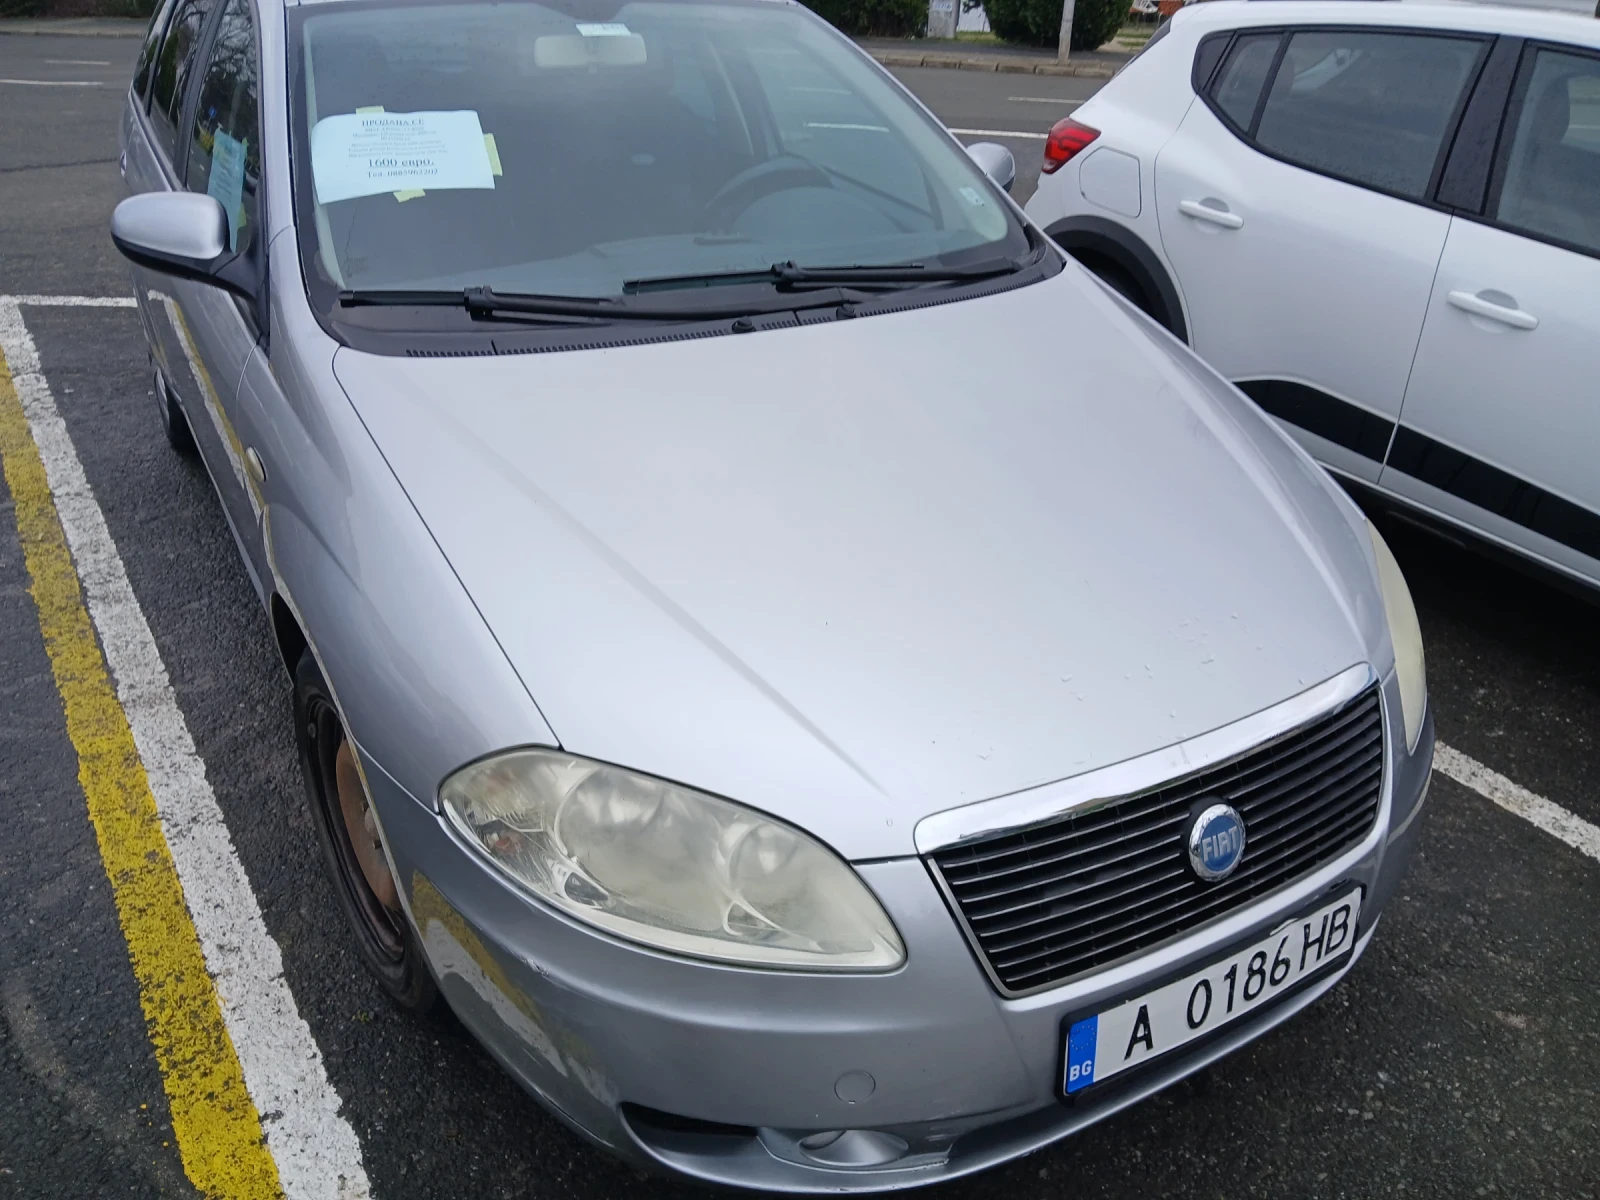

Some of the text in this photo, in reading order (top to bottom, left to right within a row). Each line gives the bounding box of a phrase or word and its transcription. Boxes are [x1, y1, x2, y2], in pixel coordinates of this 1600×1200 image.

[362, 119, 409, 127] ПРОДАВА
[369, 158, 398, 167] 1600
[1202, 825, 1238, 863] FIAT
[1123, 903, 1351, 1061] A 0186 HB
[1069, 1060, 1092, 1082] BG
